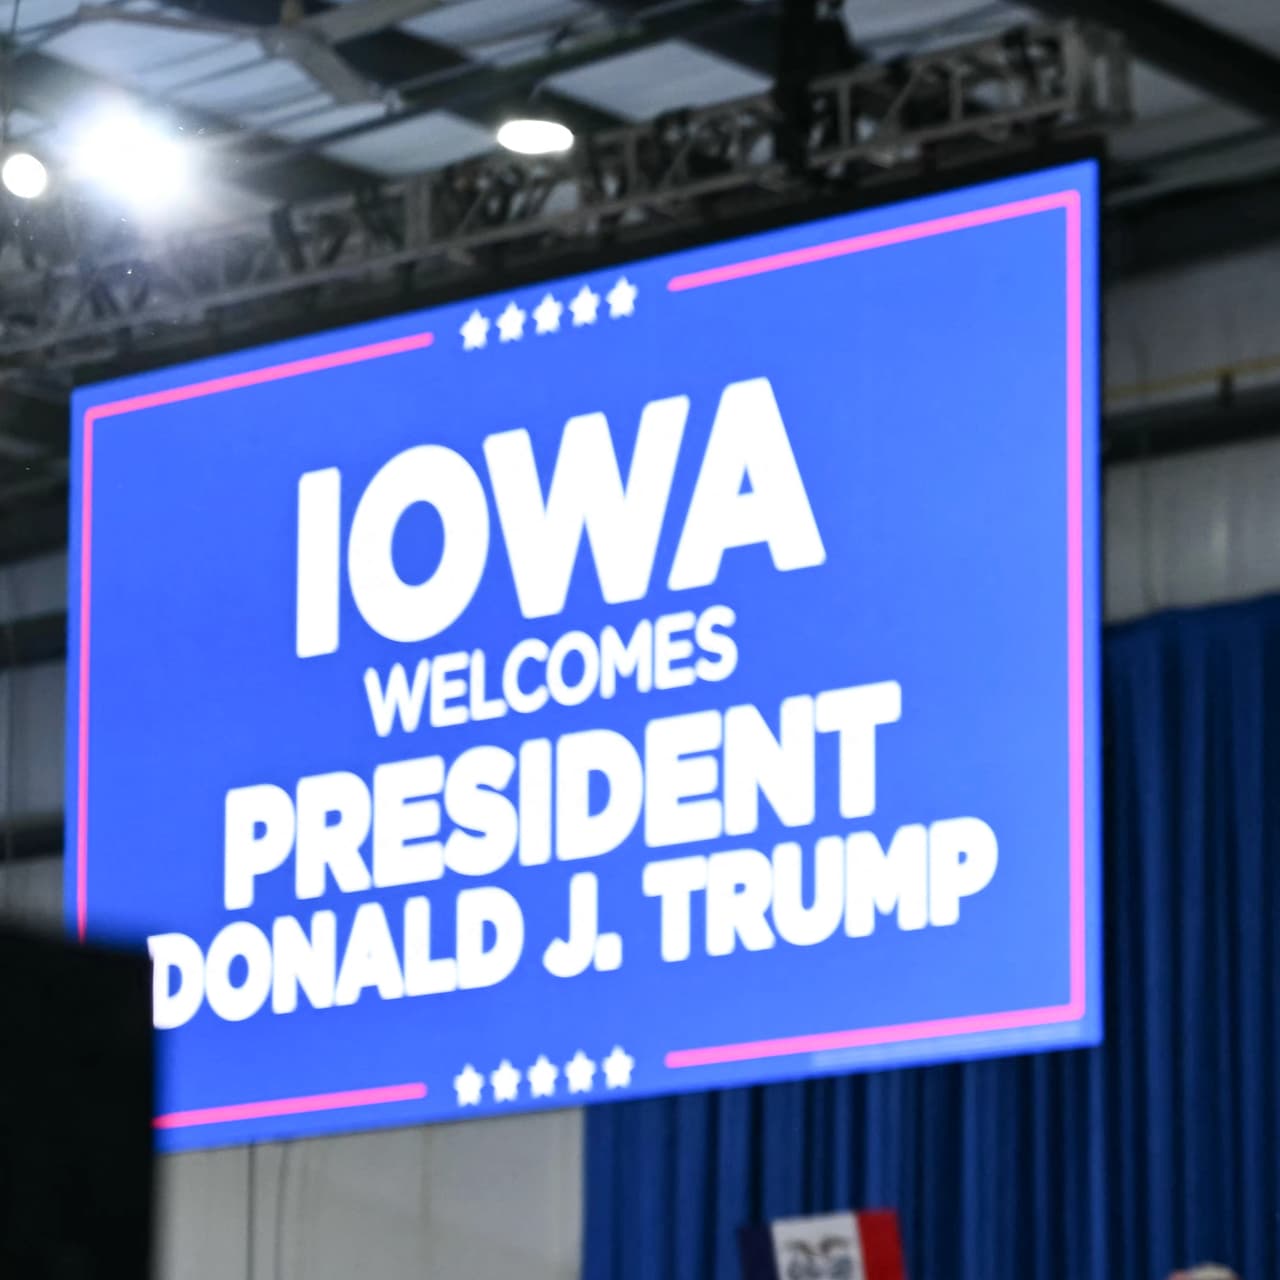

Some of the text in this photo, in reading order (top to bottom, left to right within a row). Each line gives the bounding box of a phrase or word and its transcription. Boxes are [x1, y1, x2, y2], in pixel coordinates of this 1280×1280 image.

[296, 377, 827, 658] IOWA
[363, 605, 738, 737] WELCOMES
[223, 680, 902, 910] PRESIDENT
[148, 816, 999, 1029] DONALD J. TRUMP
